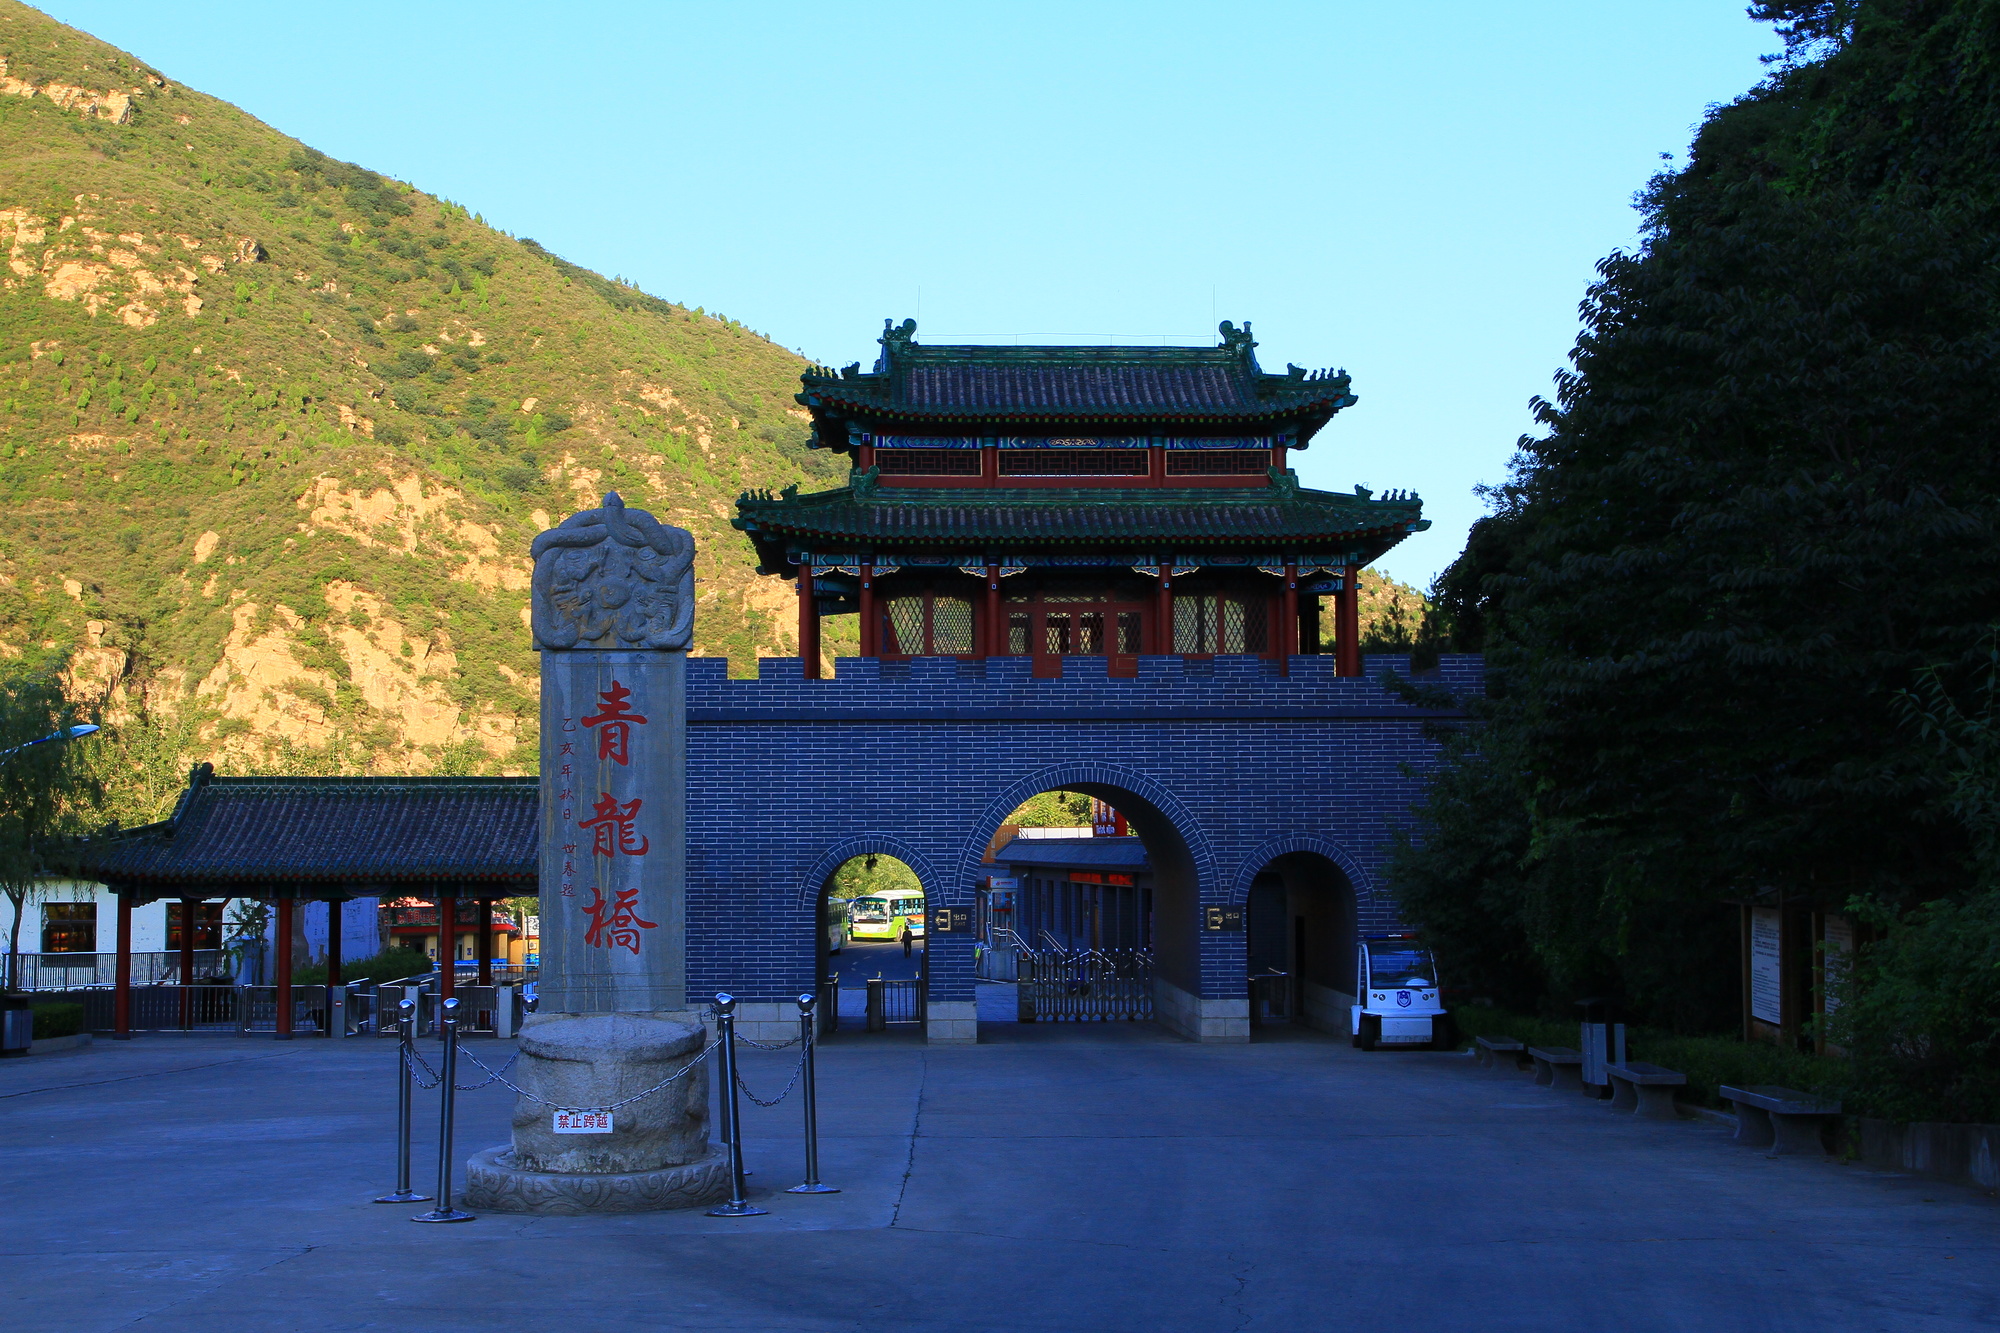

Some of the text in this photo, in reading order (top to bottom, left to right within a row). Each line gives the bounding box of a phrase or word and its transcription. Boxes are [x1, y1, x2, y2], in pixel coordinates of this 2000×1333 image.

[578, 680, 659, 955] 青龍橋
[558, 1114, 608, 1129] 禁止跨越
